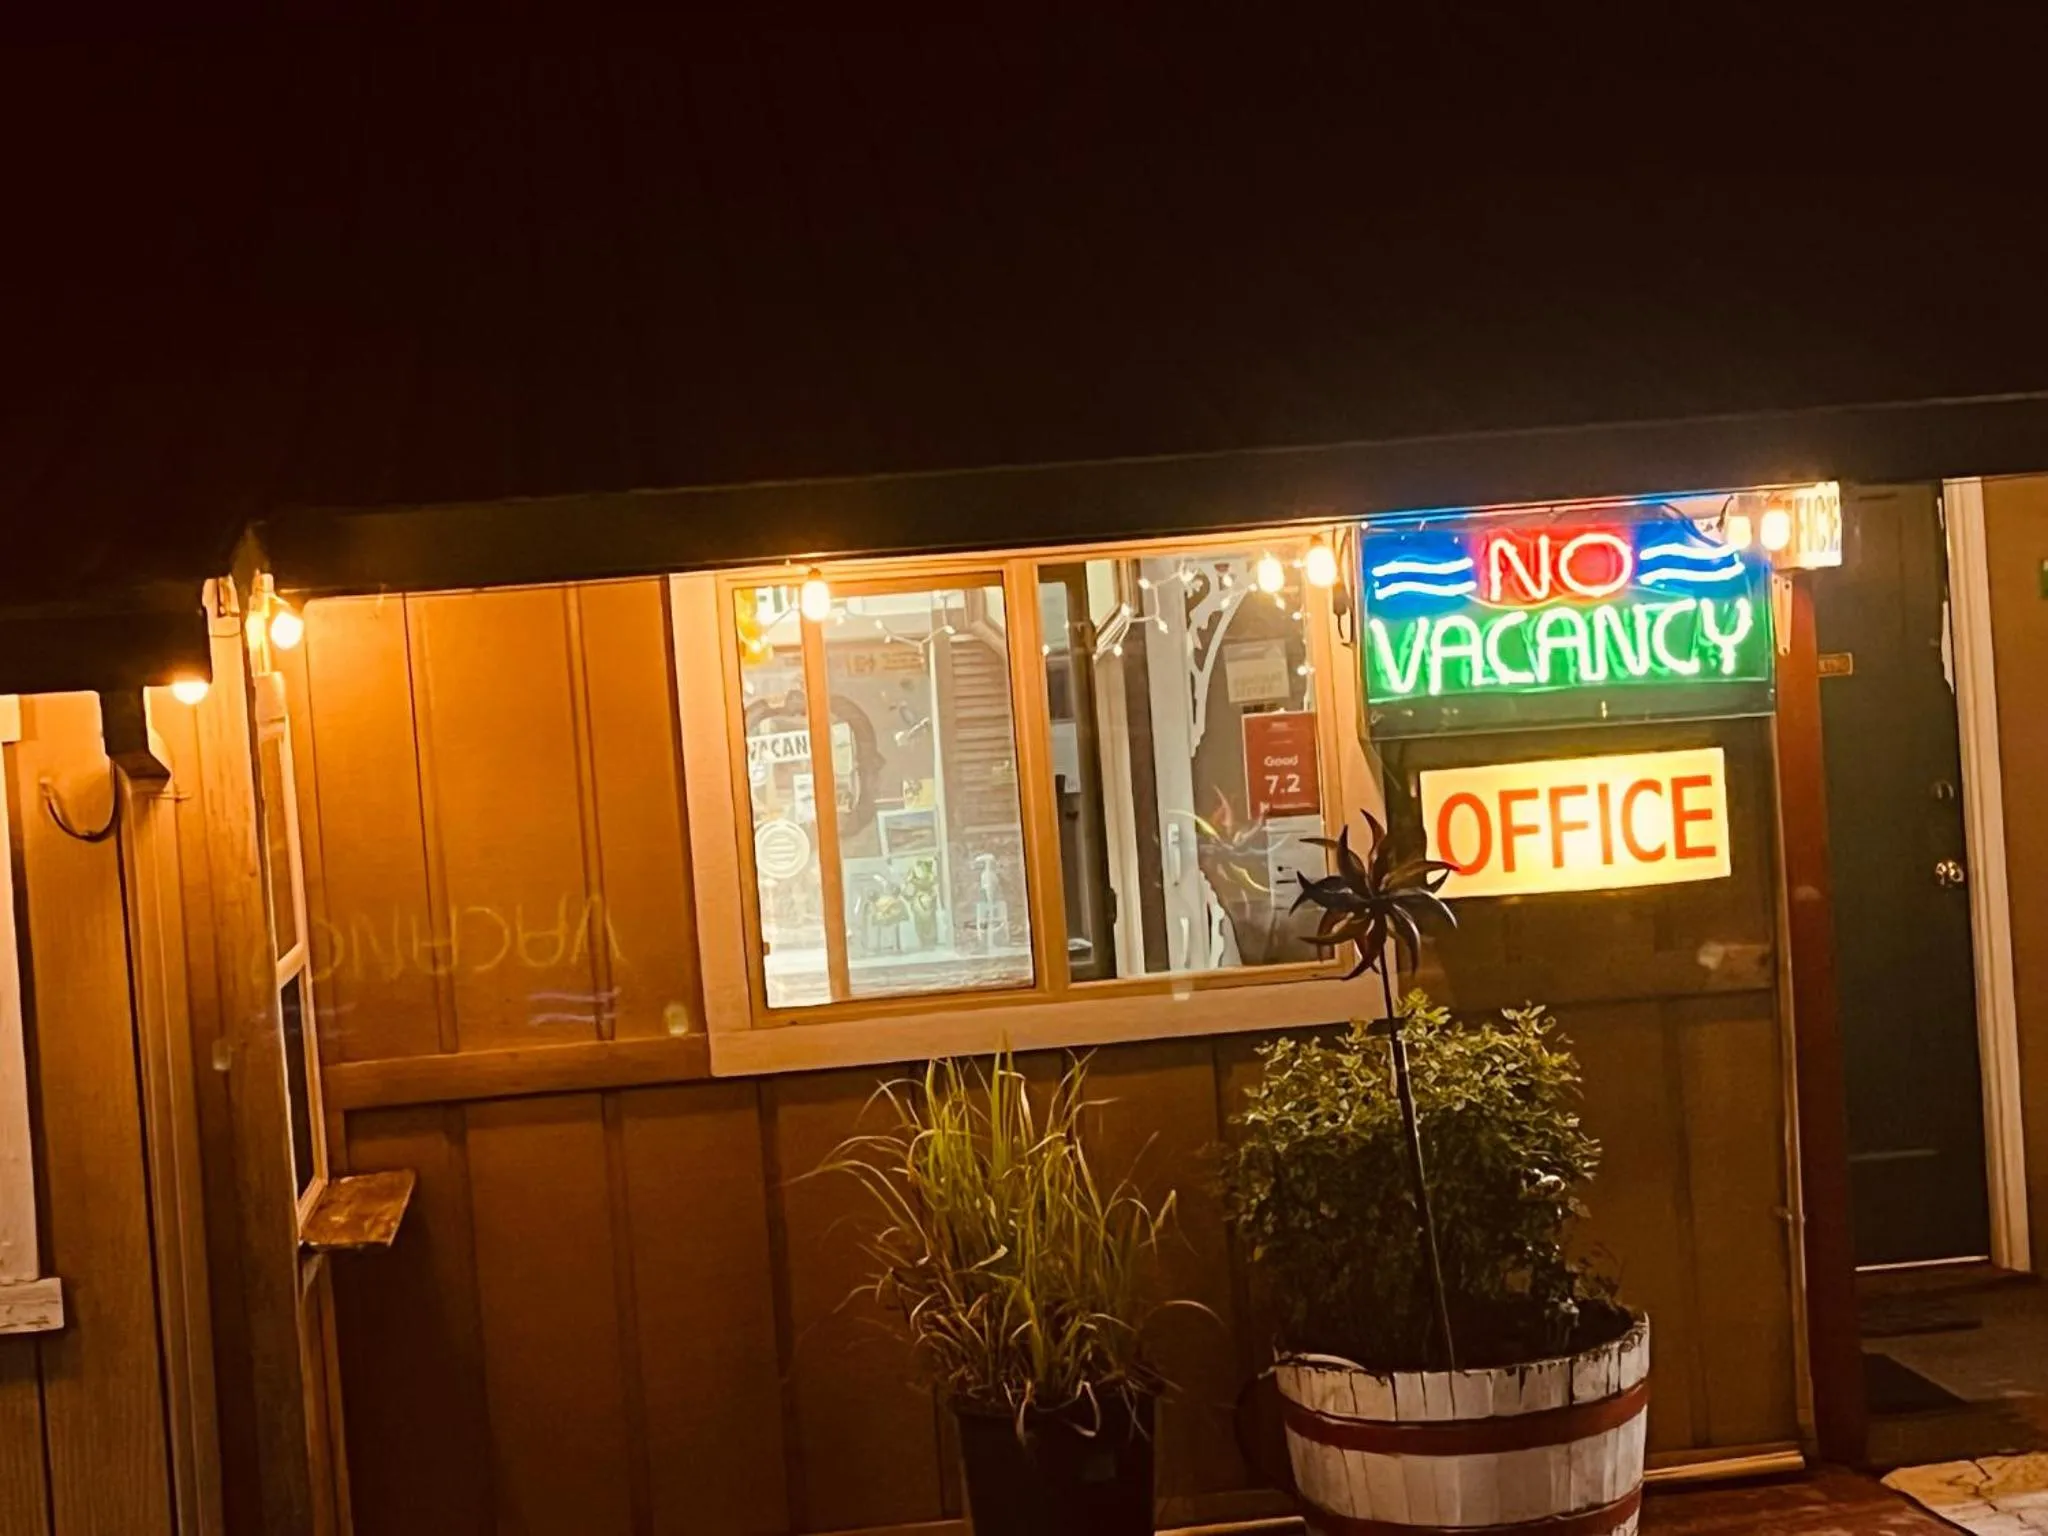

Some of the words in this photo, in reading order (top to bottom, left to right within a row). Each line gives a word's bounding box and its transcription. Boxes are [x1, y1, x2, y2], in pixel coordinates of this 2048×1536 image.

[1486, 532, 1635, 602] NO
[1368, 597, 1754, 695] VACANCY
[1264, 755, 1298, 767] Good
[1264, 773, 1301, 794] 7.2
[1436, 774, 1717, 877] OFFICE
